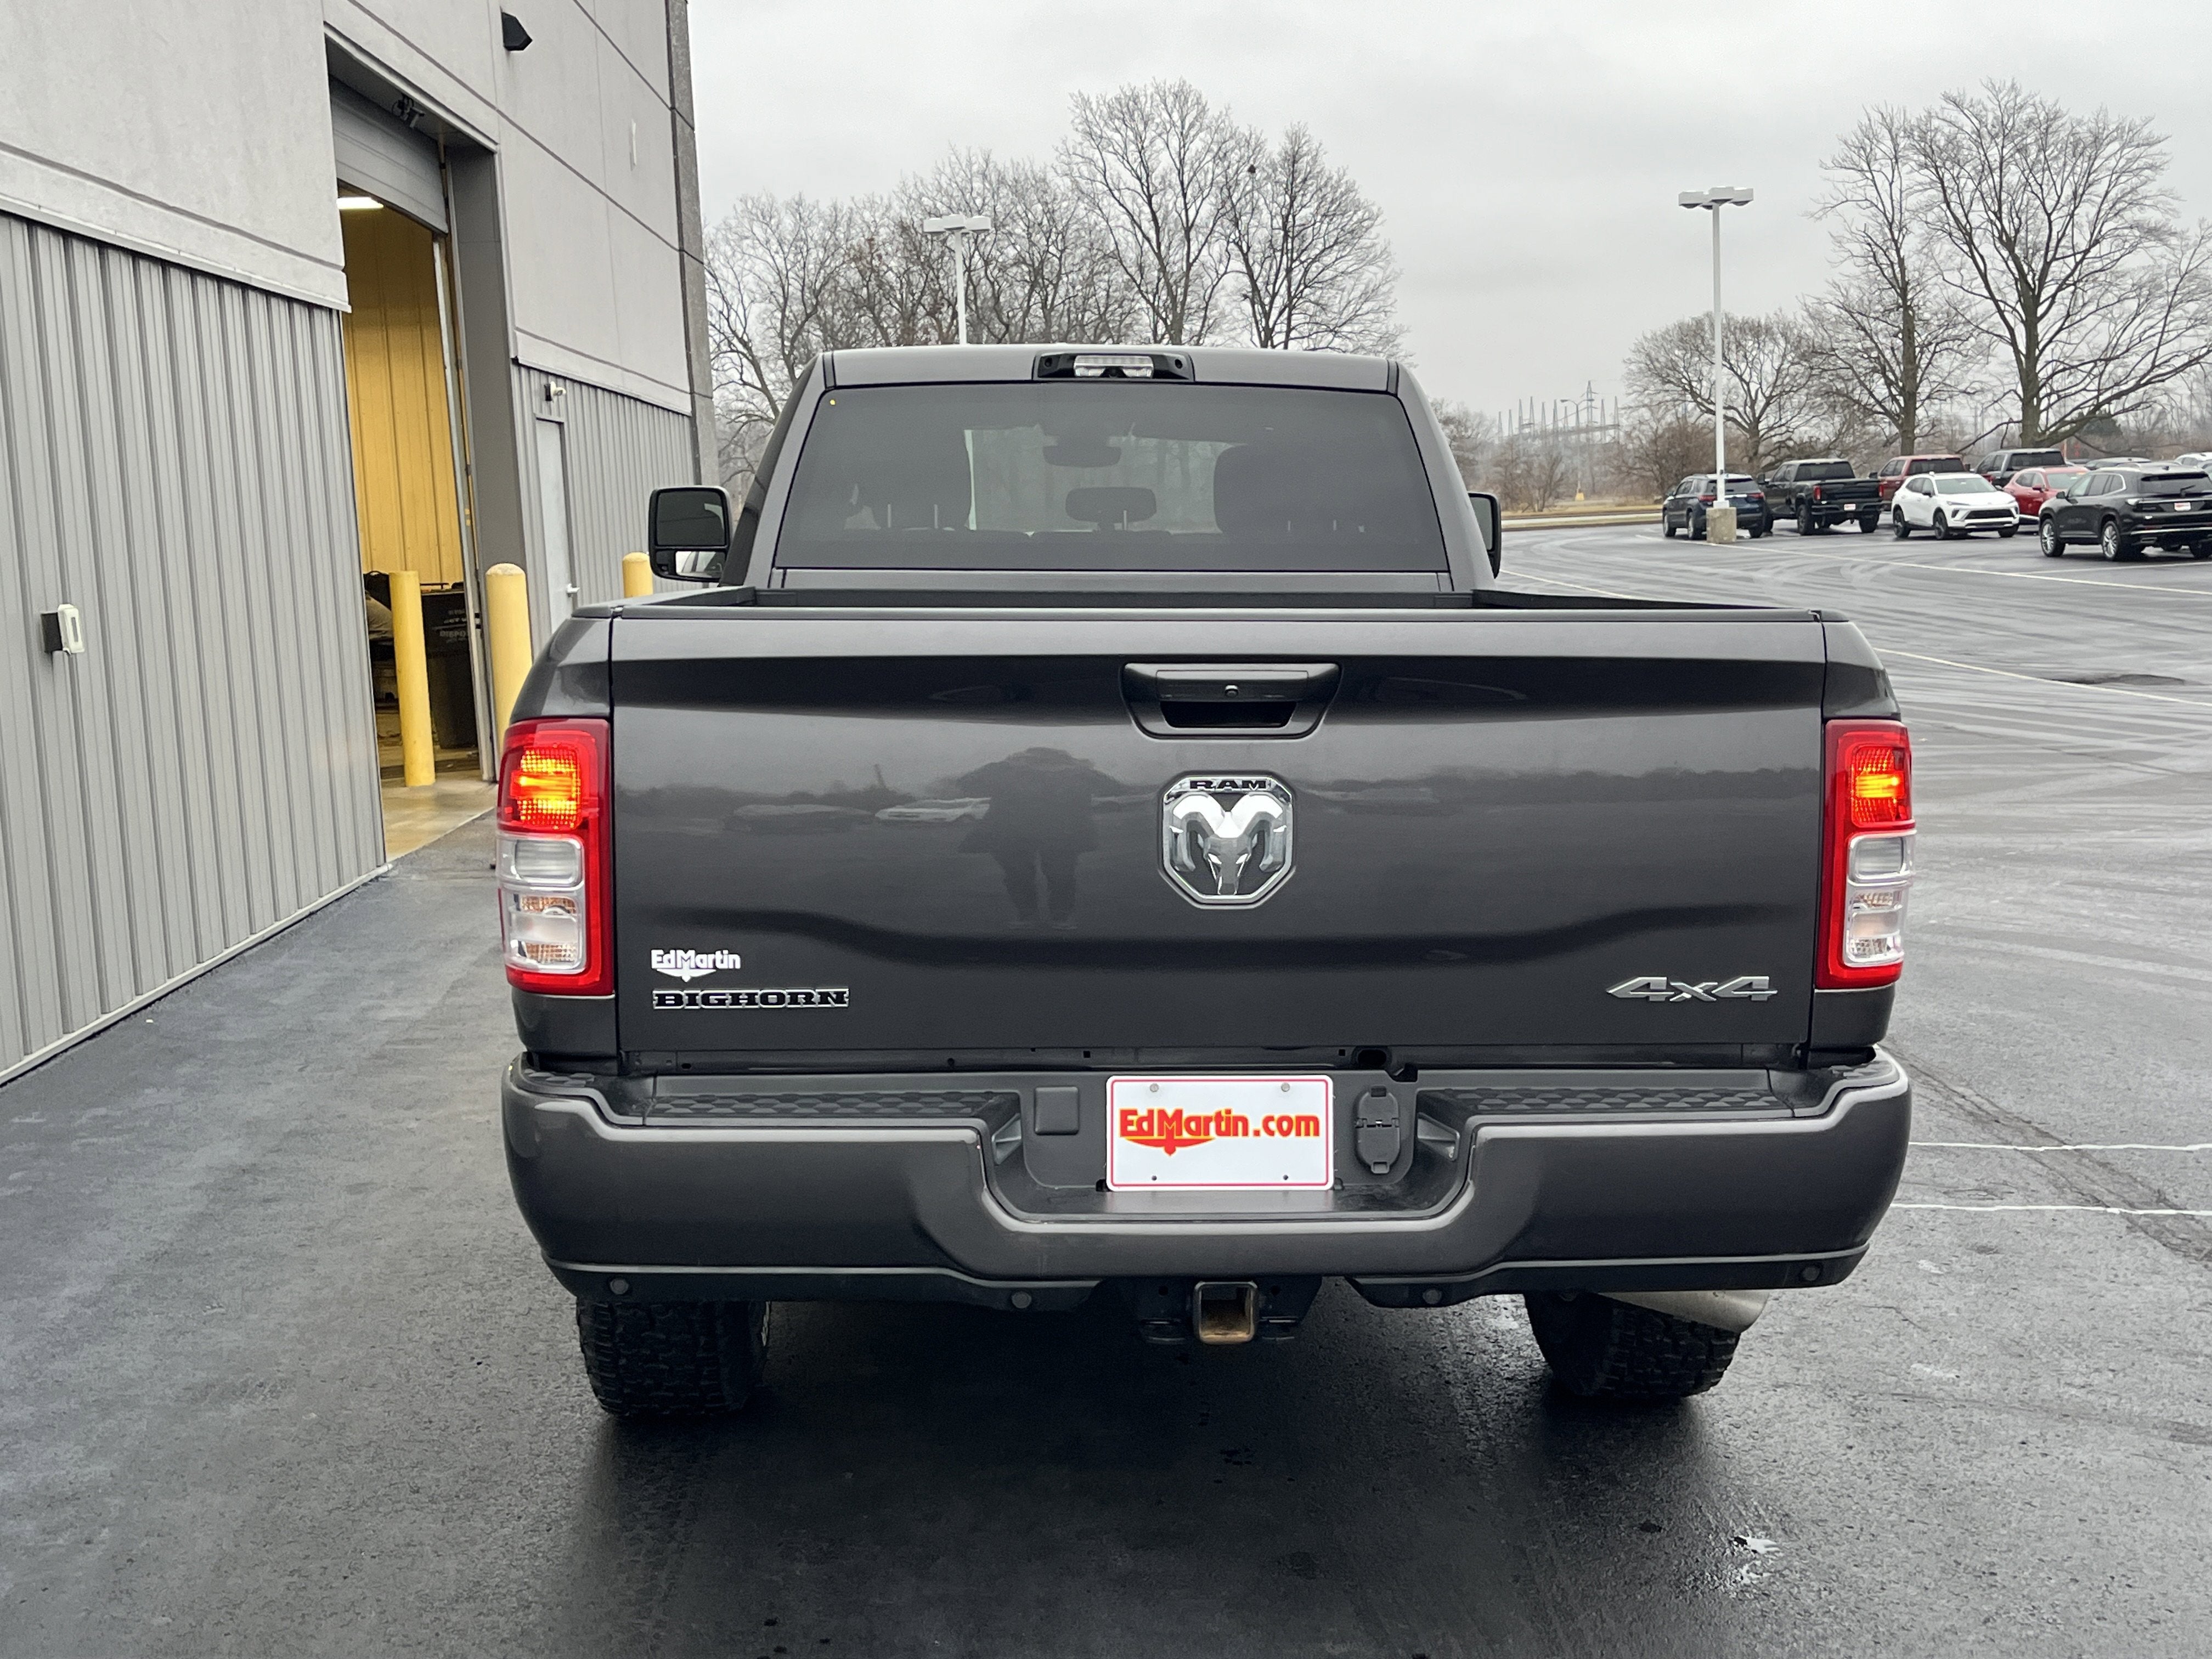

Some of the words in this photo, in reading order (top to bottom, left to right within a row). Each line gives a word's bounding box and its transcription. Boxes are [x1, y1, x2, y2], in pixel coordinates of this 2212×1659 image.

[1189, 780, 1267, 790] RAM
[651, 949, 741, 969] EdMartin
[652, 986, 850, 1010] BIGHORN
[1606, 975, 1778, 1002] 4x4
[1119, 1107, 1320, 1138] EdMartin.com
